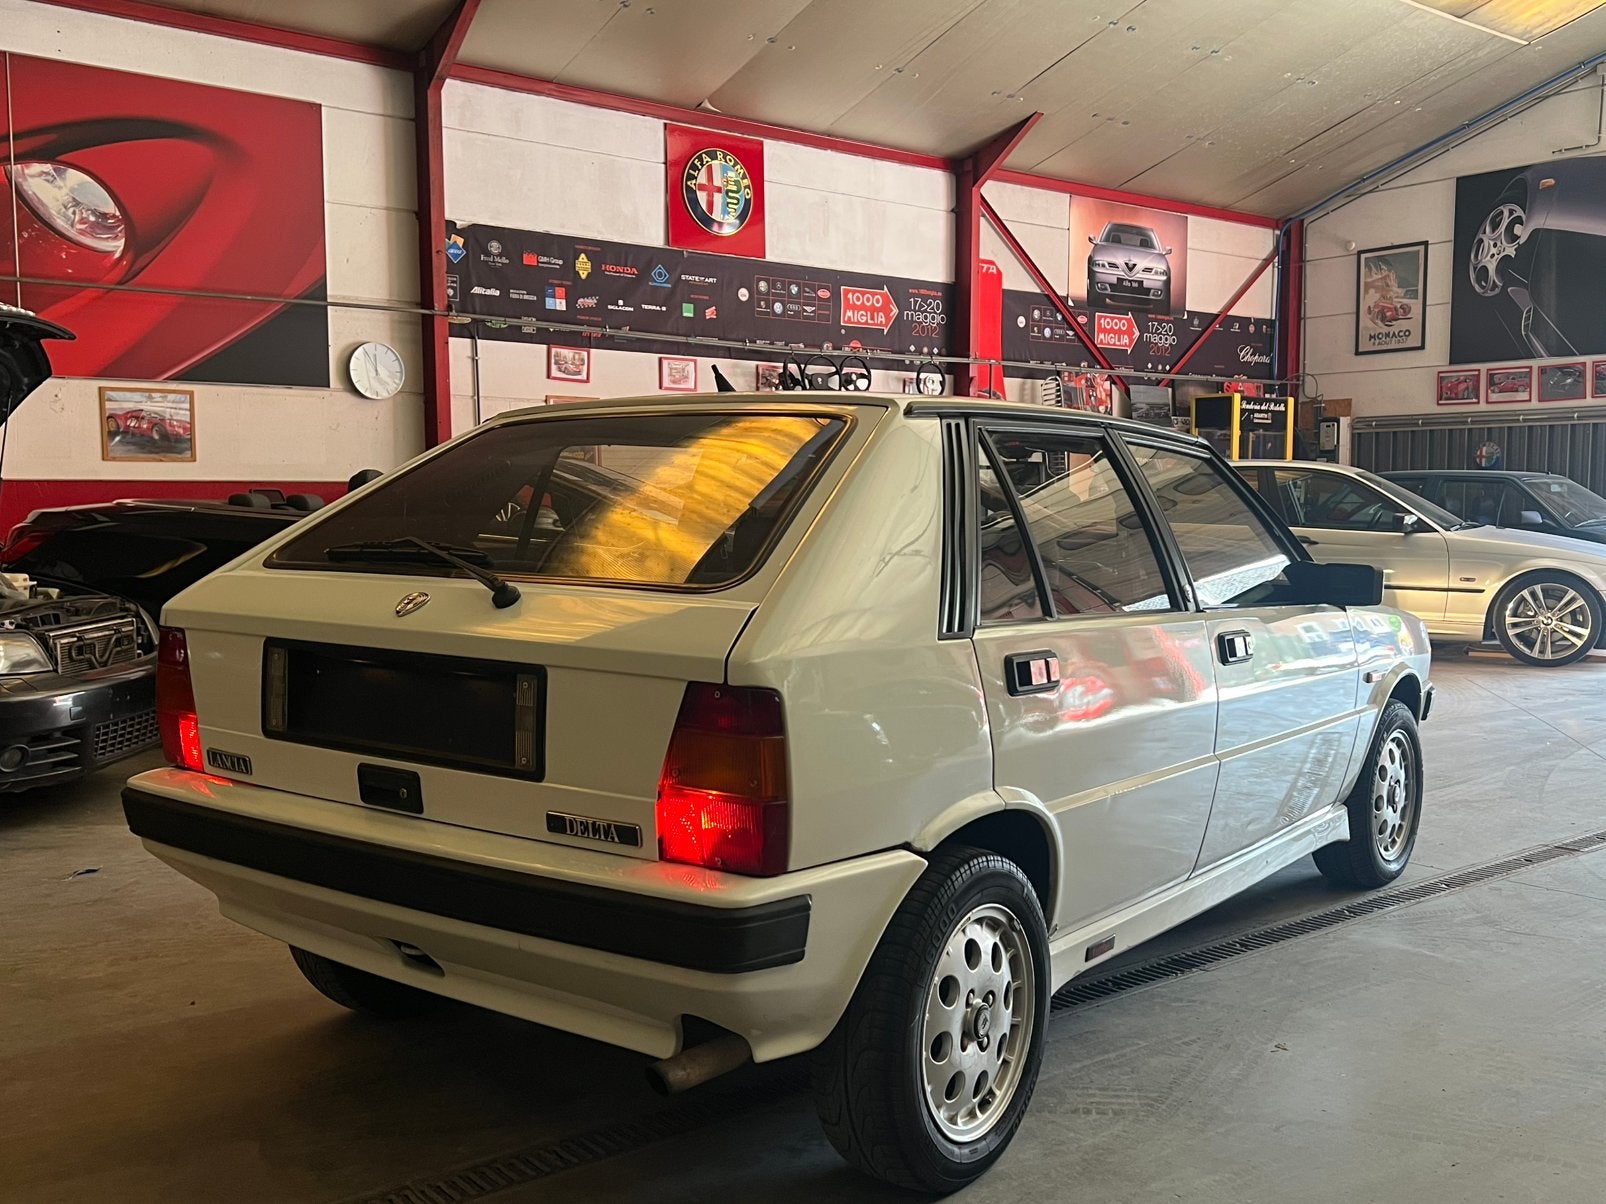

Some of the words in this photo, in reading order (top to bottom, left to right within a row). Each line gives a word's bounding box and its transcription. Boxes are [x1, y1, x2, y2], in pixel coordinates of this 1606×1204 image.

[687, 153, 711, 190] ALFA
[717, 151, 751, 199] ROMEO
[601, 264, 639, 275] HONDA
[470, 286, 500, 296] Alitalia
[847, 291, 883, 307] 1000
[909, 297, 942, 313] 17>20
[844, 309, 886, 325] MIGLIA
[903, 310, 947, 327] maggio
[1100, 317, 1128, 330] 1000
[912, 322, 940, 338] 2012
[1148, 321, 1174, 335] 17>20
[1368, 329, 1411, 342] MONACO
[1097, 332, 1130, 346] MIGLIA
[1143, 332, 1178, 347] maggio
[1149, 343, 1171, 356] 2012
[209, 750, 248, 774] LANCIA
[564, 815, 620, 843] DELTA
